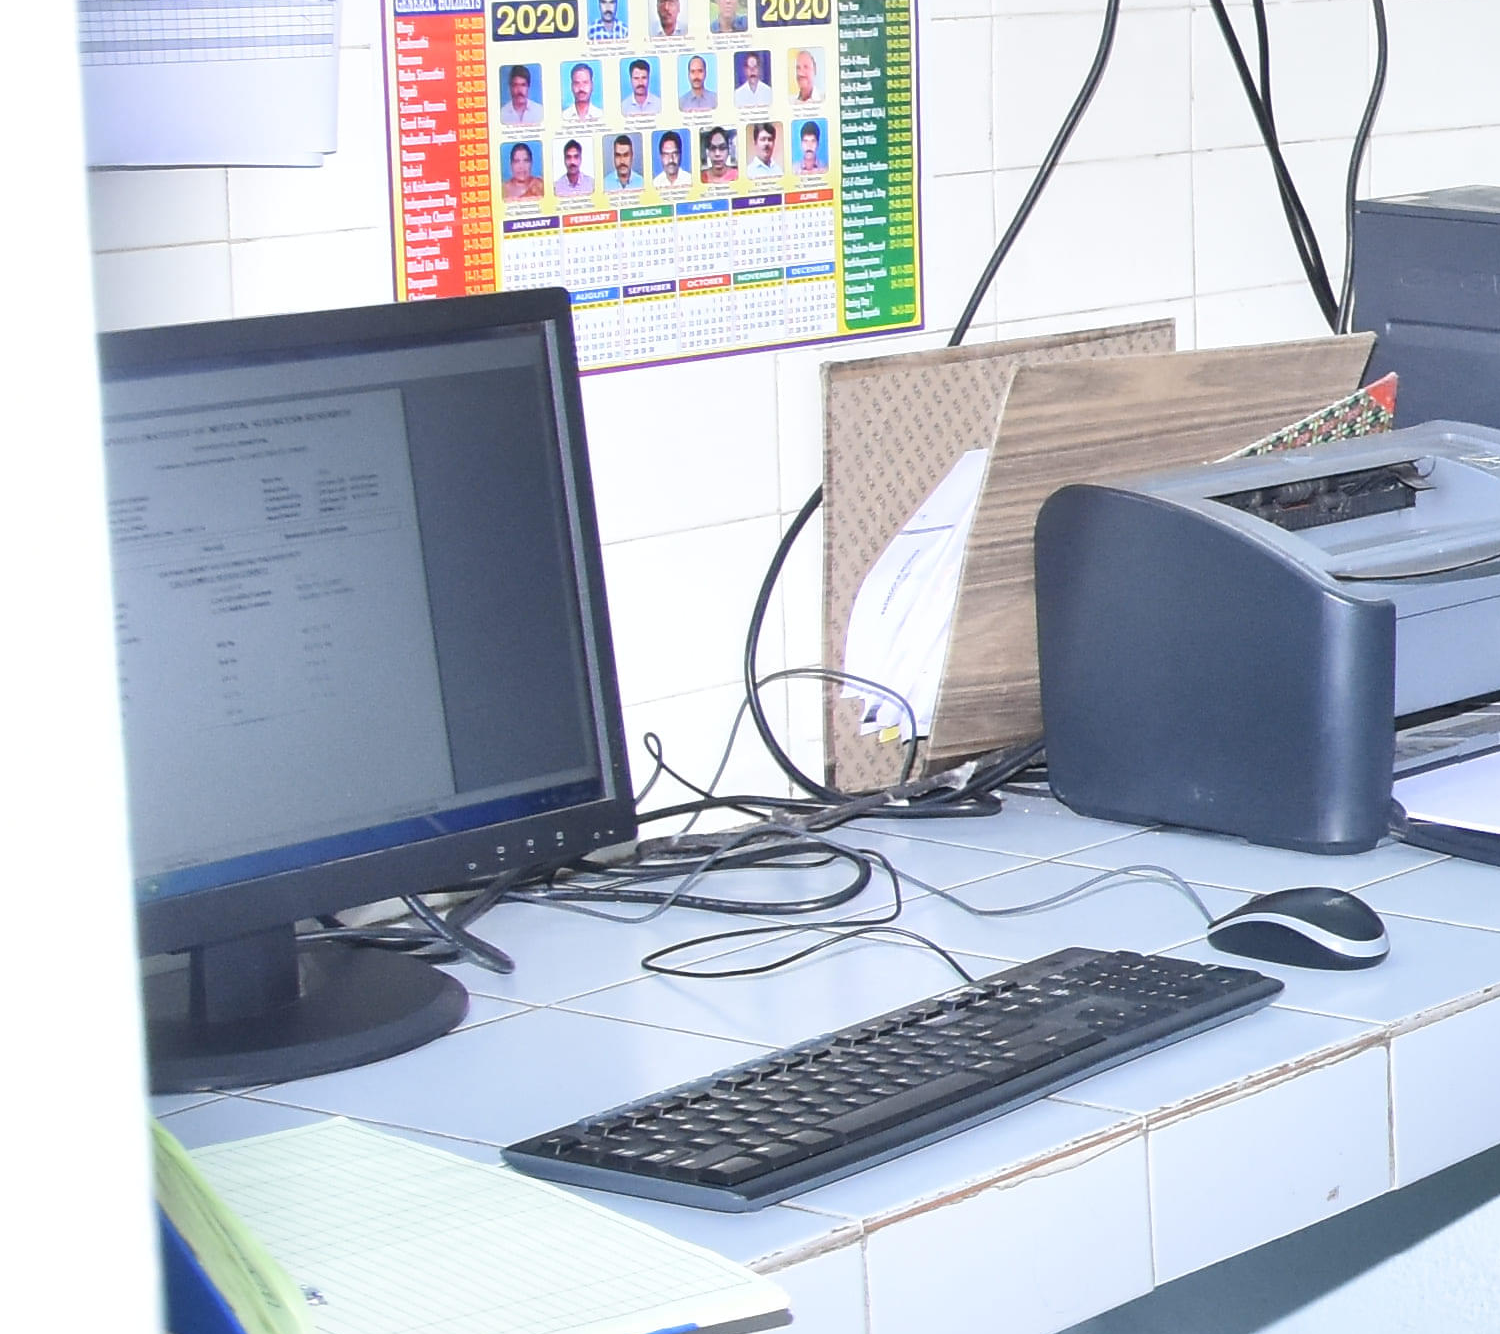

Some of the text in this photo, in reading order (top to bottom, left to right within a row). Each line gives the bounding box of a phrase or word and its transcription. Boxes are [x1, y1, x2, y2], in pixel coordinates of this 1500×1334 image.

[496, 2, 575, 35] 2020
[632, 208, 662, 217] MARCH
[570, 213, 612, 224] FEBRUARY
[511, 219, 551, 230] JANUARY
[737, 270, 780, 281] NOVEMBER
[686, 276, 724, 288] OCTOBER
[627, 282, 672, 295] SEPTEMBER
[575, 290, 610, 301] AUGUST
